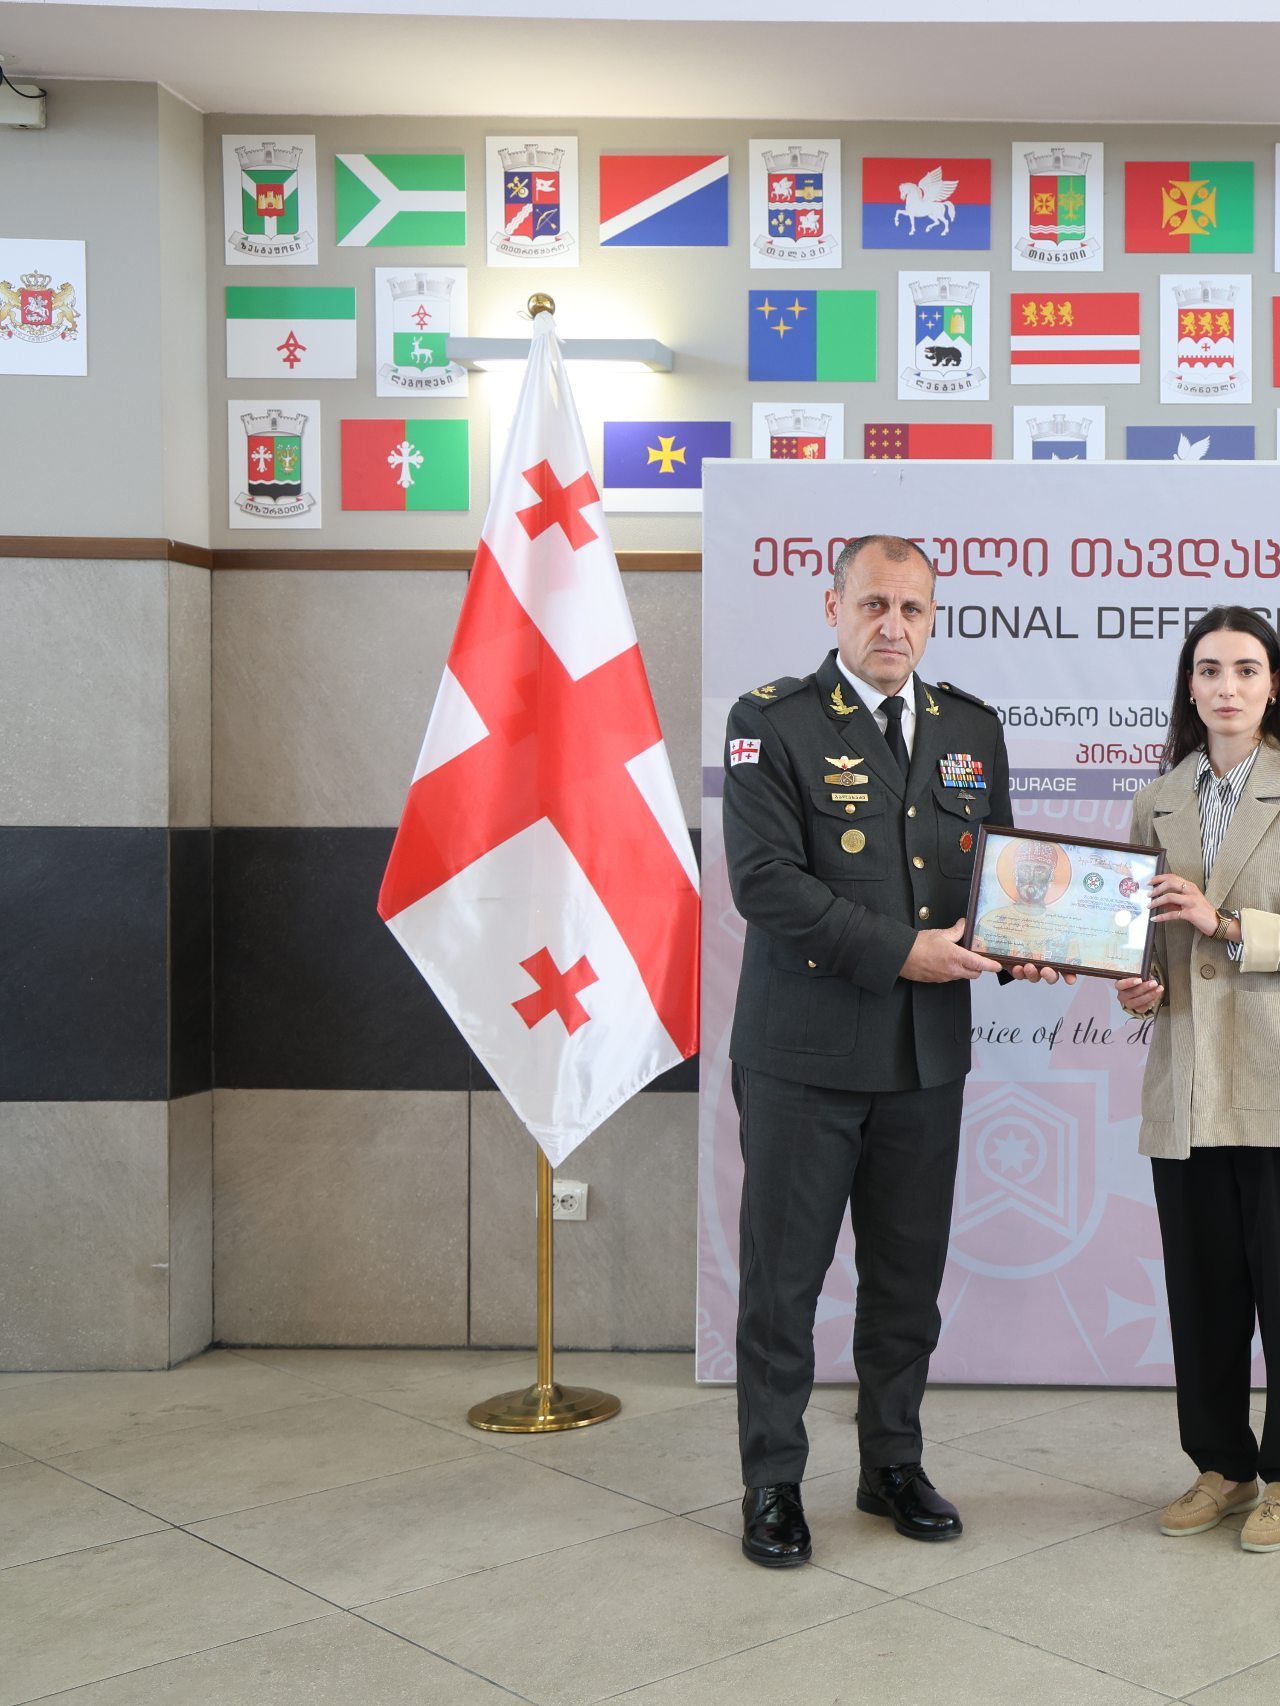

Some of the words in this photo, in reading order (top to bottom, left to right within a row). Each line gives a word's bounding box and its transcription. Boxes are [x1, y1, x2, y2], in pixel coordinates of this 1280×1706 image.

[766, 246, 825, 258] თელავი
[1028, 249, 1087, 262] თიანეთი
[391, 375, 453, 387] ლაგოდეხი
[1176, 383, 1236, 394] მარნეული
[753, 536, 1048, 577] ერული
[931, 606, 1079, 639] TIONAL
[997, 706, 1098, 727] ანგარო
[1076, 743, 1166, 764] პირად
[1009, 777, 1076, 791] OURAGE
[971, 1021, 1023, 1044] vice
[1033, 1016, 1064, 1050] of
[1072, 1016, 1114, 1045] the
